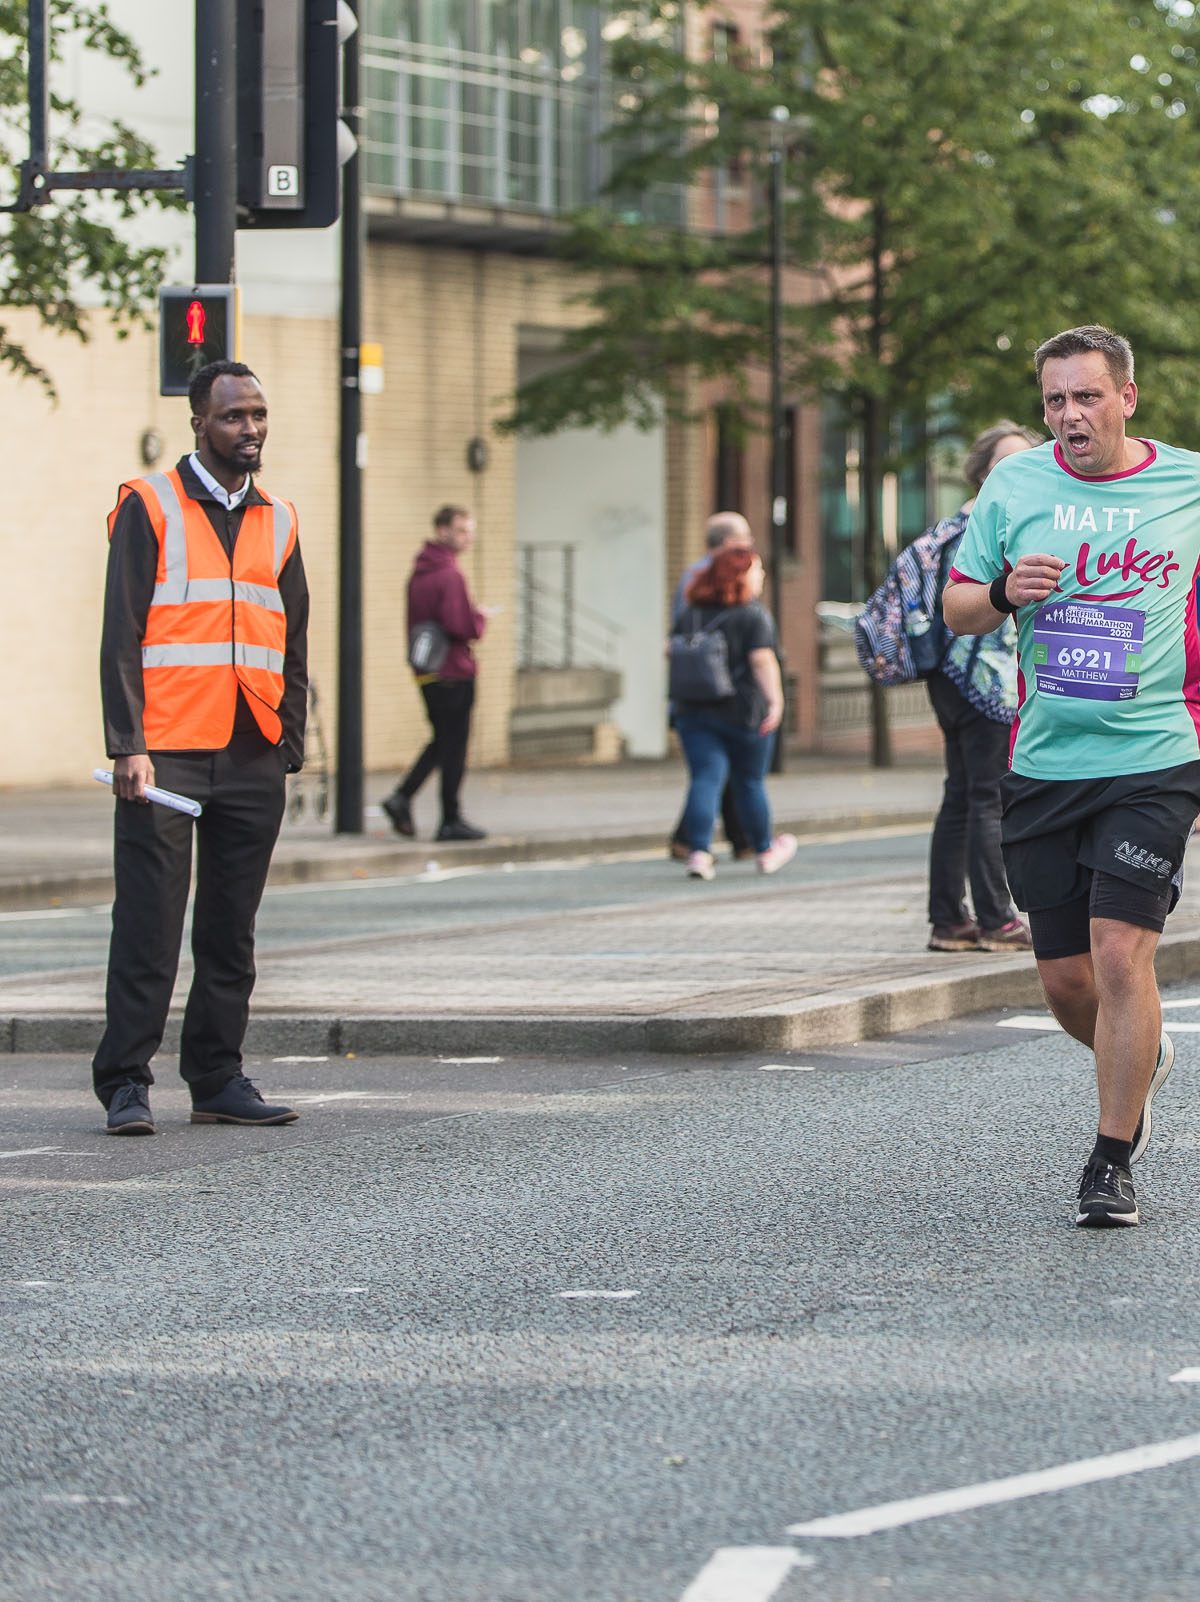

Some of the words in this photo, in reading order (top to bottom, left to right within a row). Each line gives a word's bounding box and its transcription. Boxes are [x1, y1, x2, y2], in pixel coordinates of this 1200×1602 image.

[277, 170, 290, 191] B
[1053, 504, 1140, 532] MATT
[1075, 537, 1180, 588] Luke's
[1066, 609, 1103, 620] SHEFFIELD
[1086, 619, 1132, 630] MARATHON
[1110, 629, 1132, 638] 2020
[1123, 643, 1135, 651] XL
[1058, 648, 1111, 669] 6921
[1061, 668, 1108, 681] MATTHEW
[1117, 840, 1173, 875] NIKE
